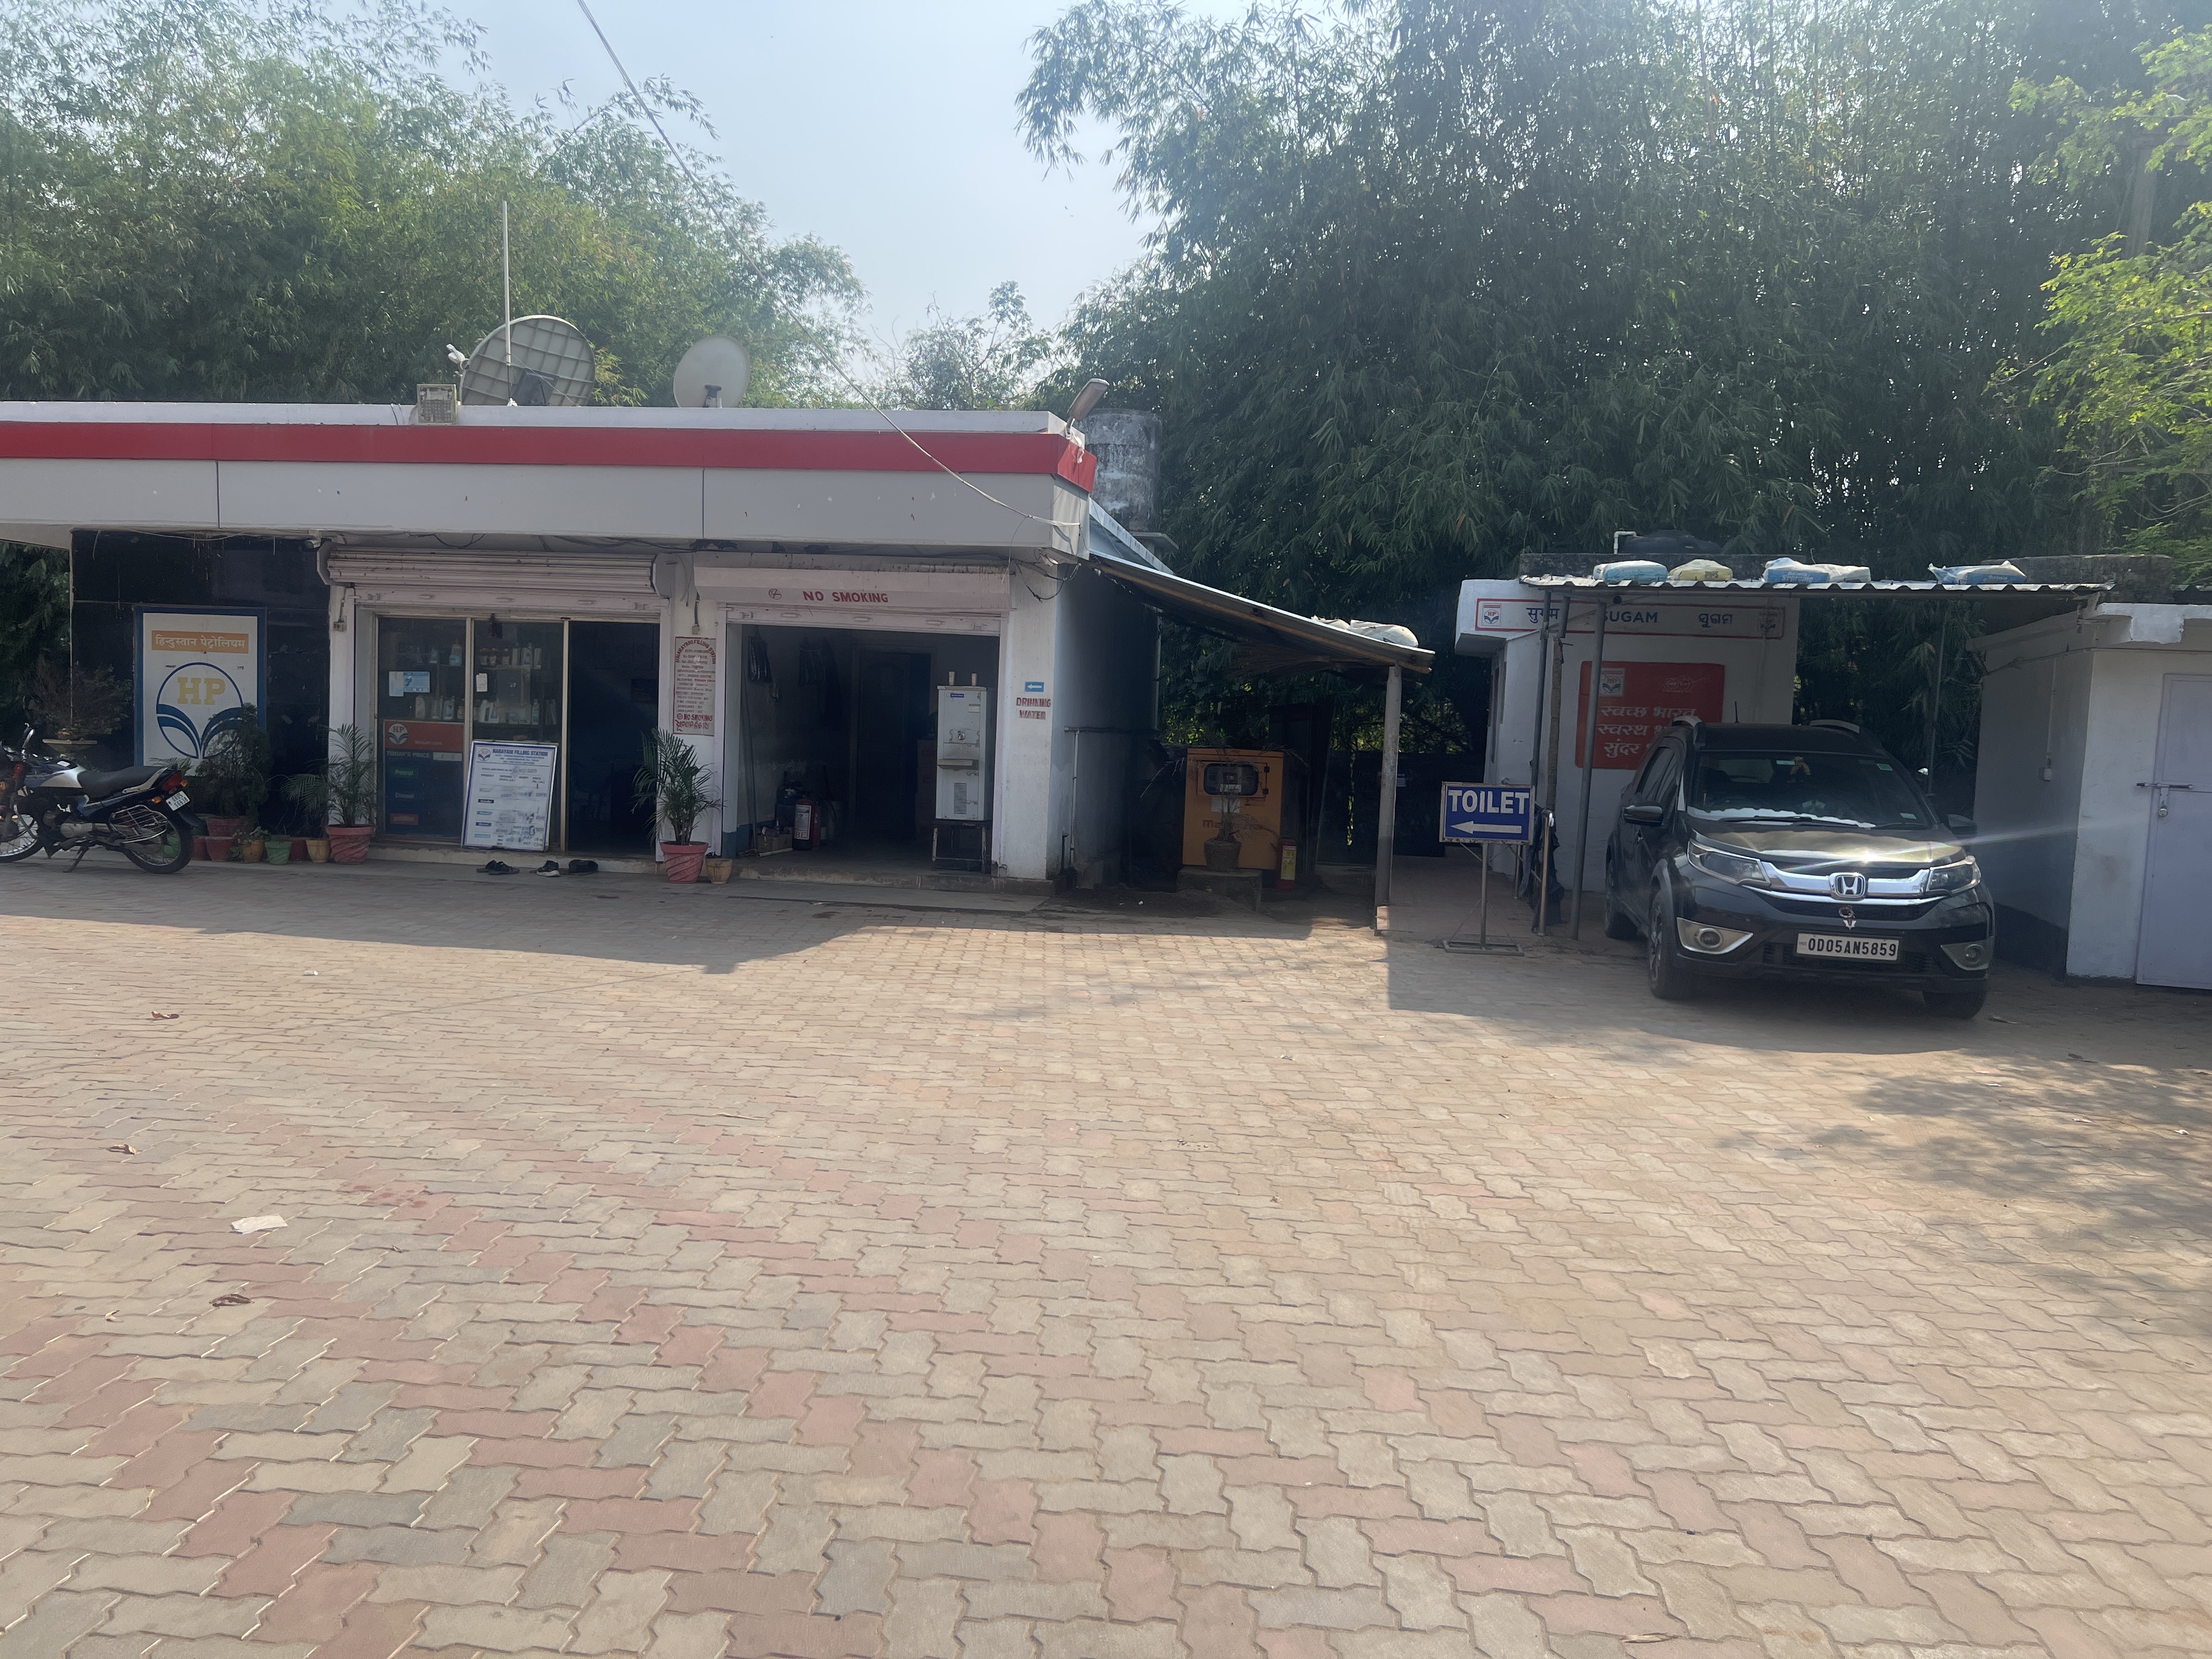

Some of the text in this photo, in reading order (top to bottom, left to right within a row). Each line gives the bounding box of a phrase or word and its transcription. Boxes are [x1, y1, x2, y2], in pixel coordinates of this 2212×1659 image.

[803, 591, 888, 603] NO SMOKING
[155, 634, 198, 648] हिन्दुस्तान
[177, 677, 226, 706] HP
[1016, 697, 1051, 707] DRINKING
[1019, 710, 1046, 720] WATER
[1448, 789, 1530, 815] TOILET
[1808, 938, 1897, 956] OD05AN5859
